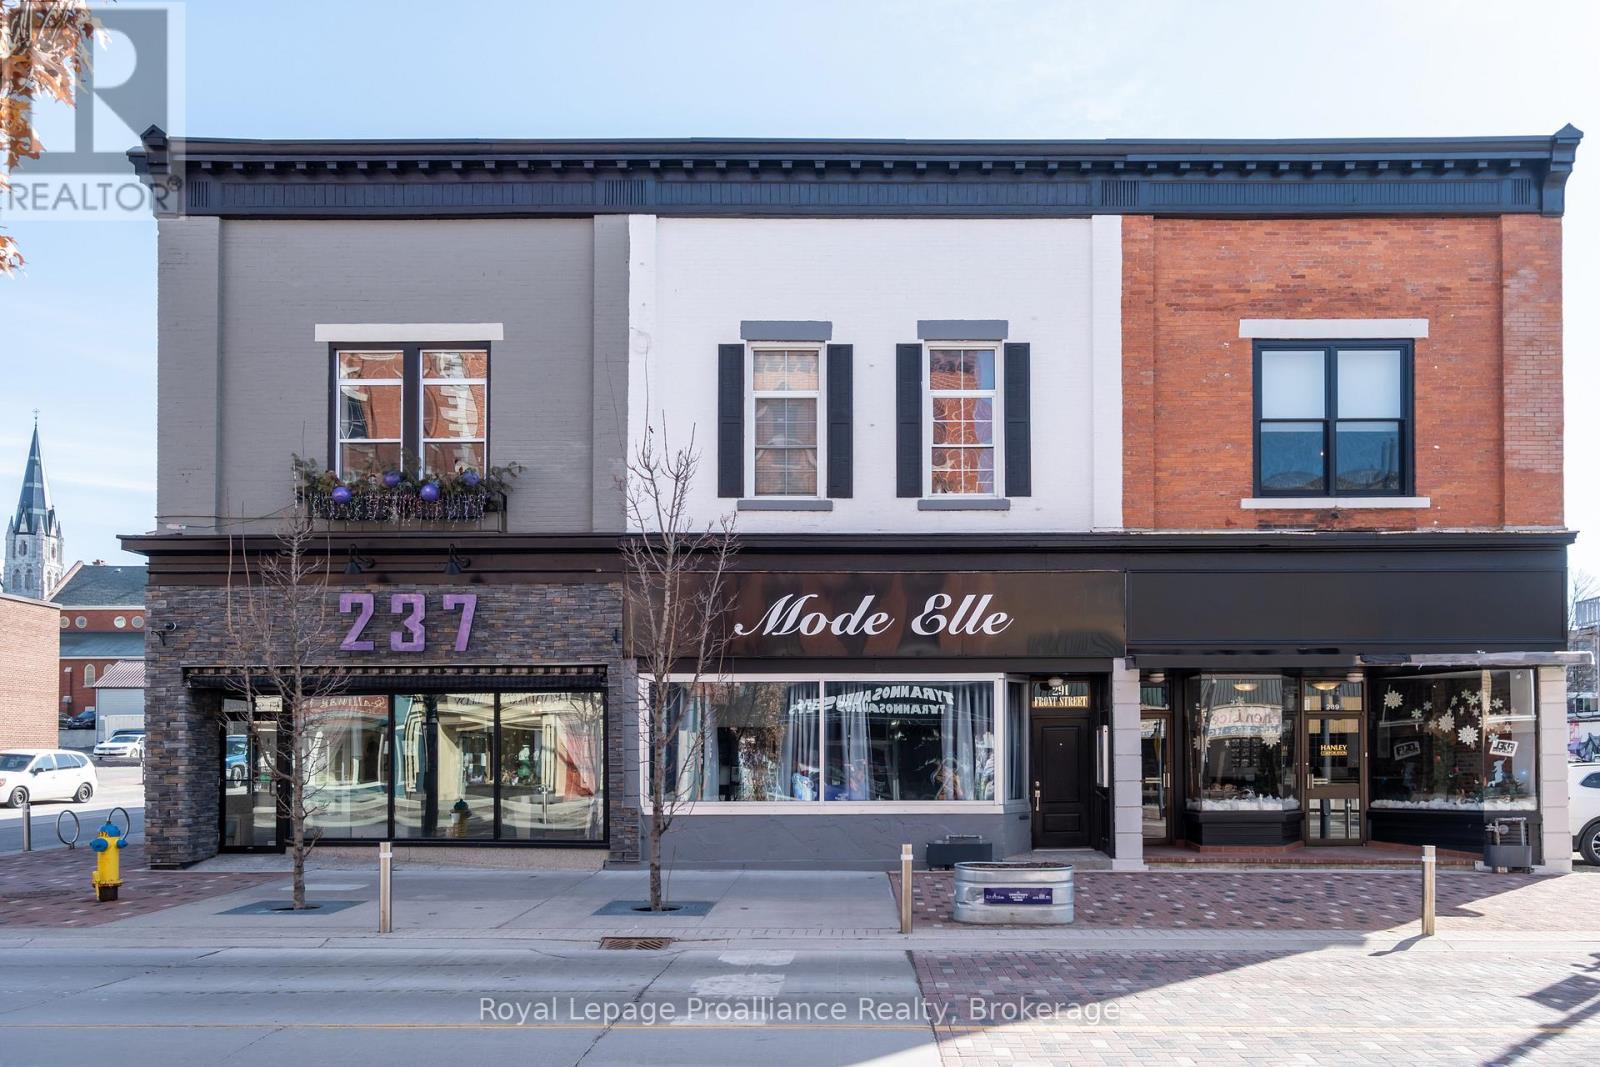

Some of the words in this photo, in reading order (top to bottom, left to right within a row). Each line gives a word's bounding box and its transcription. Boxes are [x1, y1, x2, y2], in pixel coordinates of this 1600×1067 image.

[339, 593, 477, 651] 237
[734, 593, 895, 636] Mode
[911, 593, 1014, 636] Elle
[1034, 696, 1058, 707] FRONT
[1059, 695, 1088, 707] STREET
[1052, 684, 1069, 696] 291
